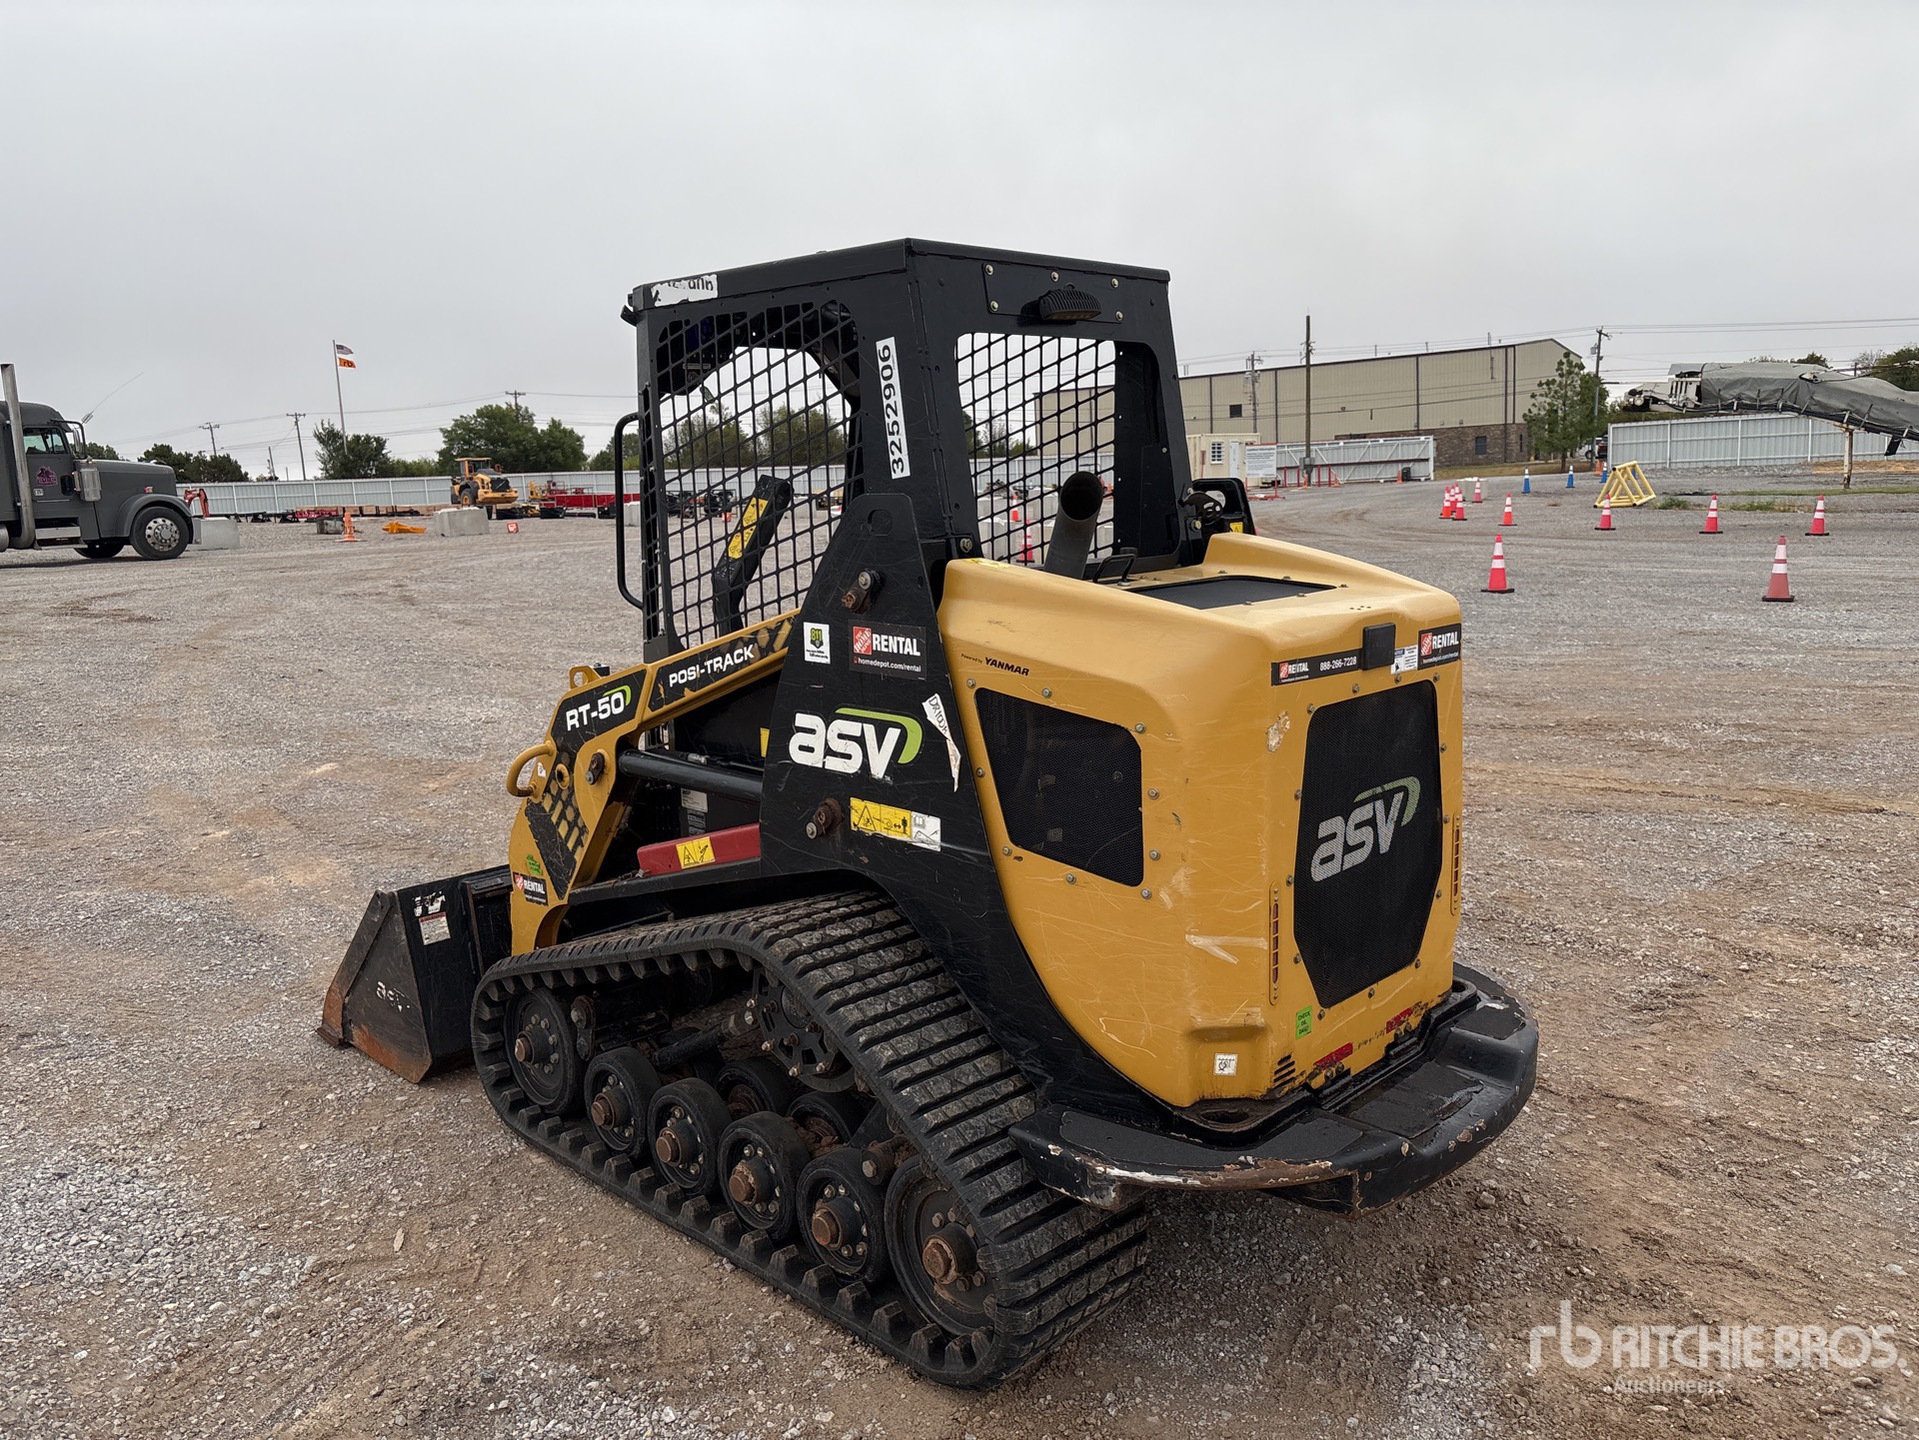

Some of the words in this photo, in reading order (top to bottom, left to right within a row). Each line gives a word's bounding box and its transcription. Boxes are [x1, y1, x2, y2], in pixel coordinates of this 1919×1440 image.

[878, 345, 904, 474] 3252906
[811, 628, 822, 641] 811
[872, 633, 921, 656] RENTAL
[1432, 631, 1459, 649] RENTAL
[669, 644, 755, 688] POSI-TRACK
[858, 657, 921, 672] homedepot.com/rental
[985, 657, 1029, 676] YANMAR
[1288, 662, 1309, 674] RENTAL
[566, 691, 624, 731] RT-50
[789, 712, 901, 779] asv
[1310, 791, 1404, 882] asv
[523, 879, 546, 895] RENTAL
